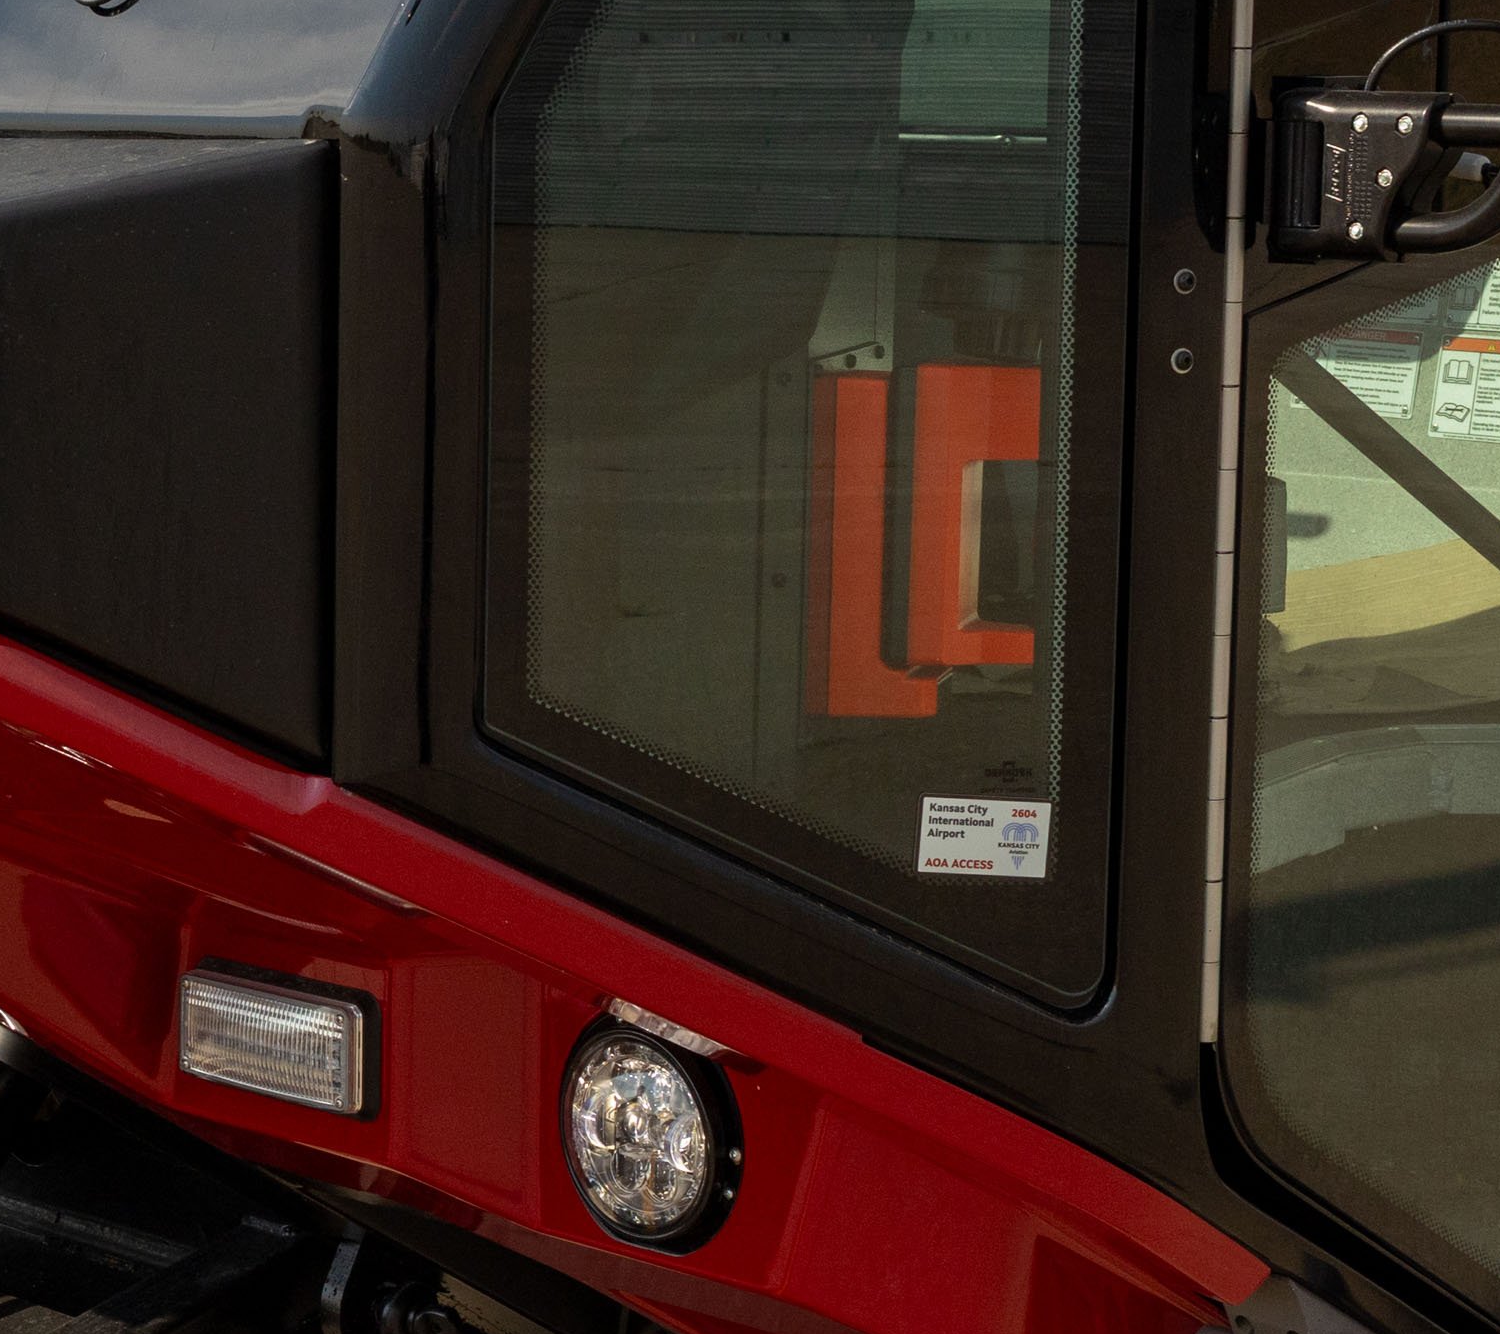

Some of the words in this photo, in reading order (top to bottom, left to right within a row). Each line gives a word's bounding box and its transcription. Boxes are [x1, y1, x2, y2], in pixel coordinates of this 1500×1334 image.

[929, 802, 965, 814] Kansas
[967, 804, 989, 816] City
[1011, 809, 1038, 819] 2604
[928, 815, 994, 827] International
[927, 828, 966, 841] Airport
[997, 842, 1024, 850] KANSAS
[924, 858, 949, 869] AOA
[951, 859, 994, 870] ACCESS
